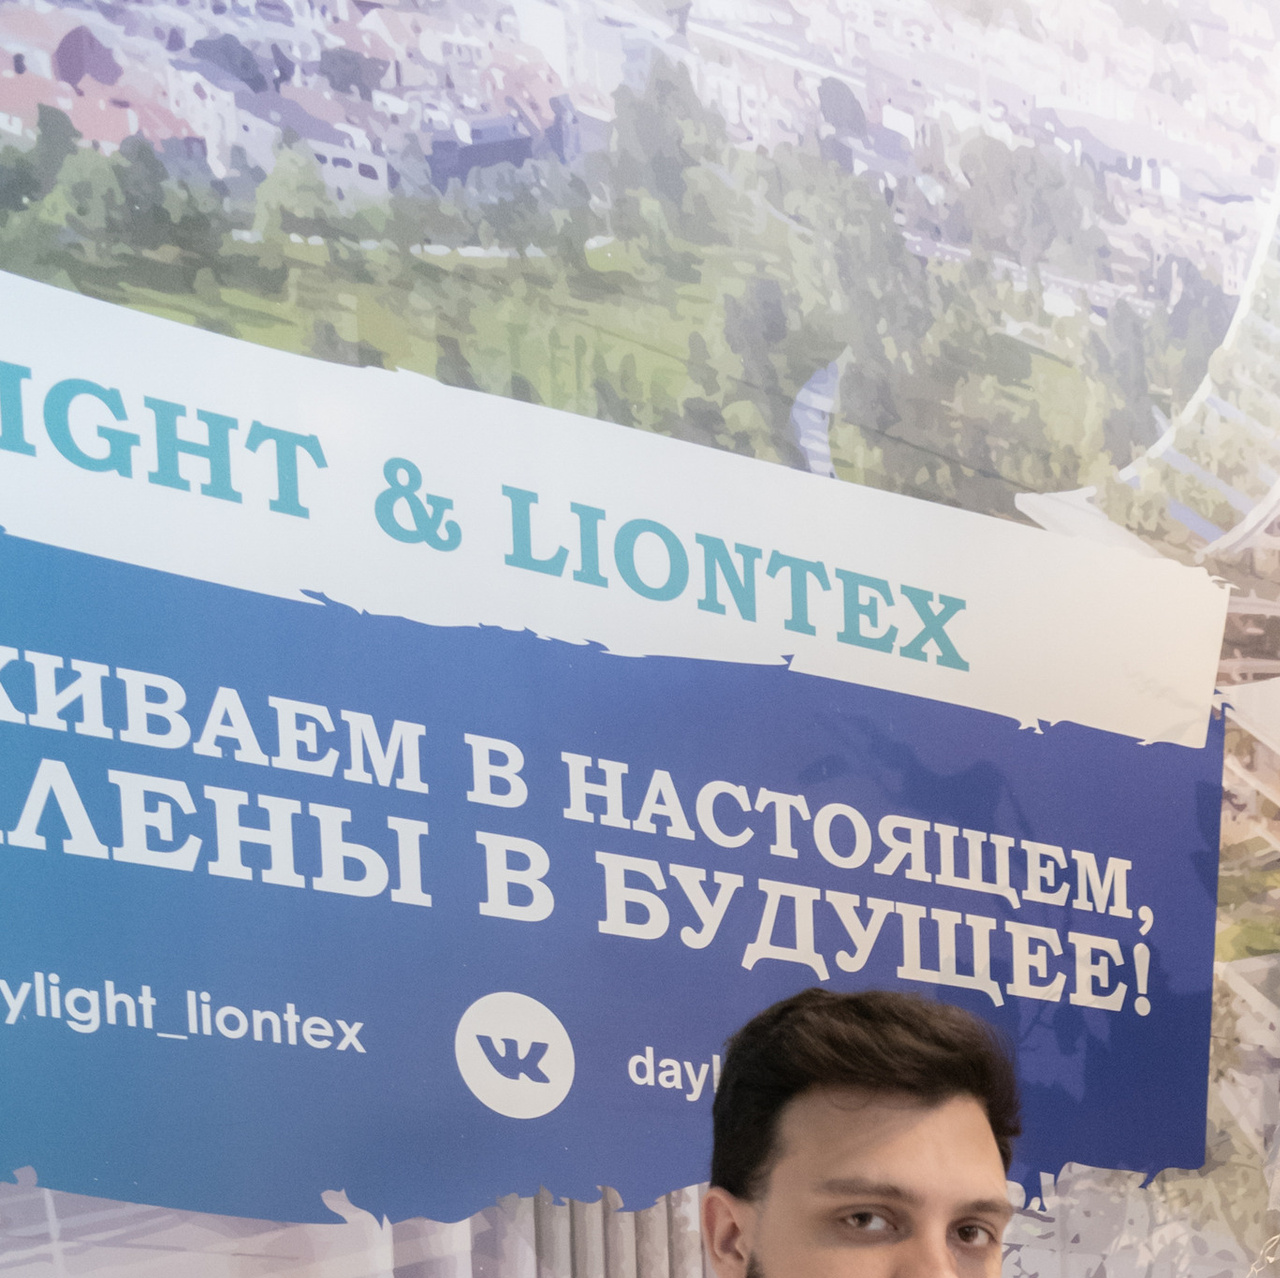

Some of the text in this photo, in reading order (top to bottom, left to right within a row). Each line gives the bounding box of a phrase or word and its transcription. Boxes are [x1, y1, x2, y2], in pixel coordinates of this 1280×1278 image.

[374, 457, 462, 552] &
[501, 484, 970, 672] LIONTEX
[0, 758, 1152, 1017] ЛЕНЫ В БУДУЩЕЕ!
[464, 733, 528, 808] В
[561, 750, 1154, 933] НАСТОЯЩЕМ,
